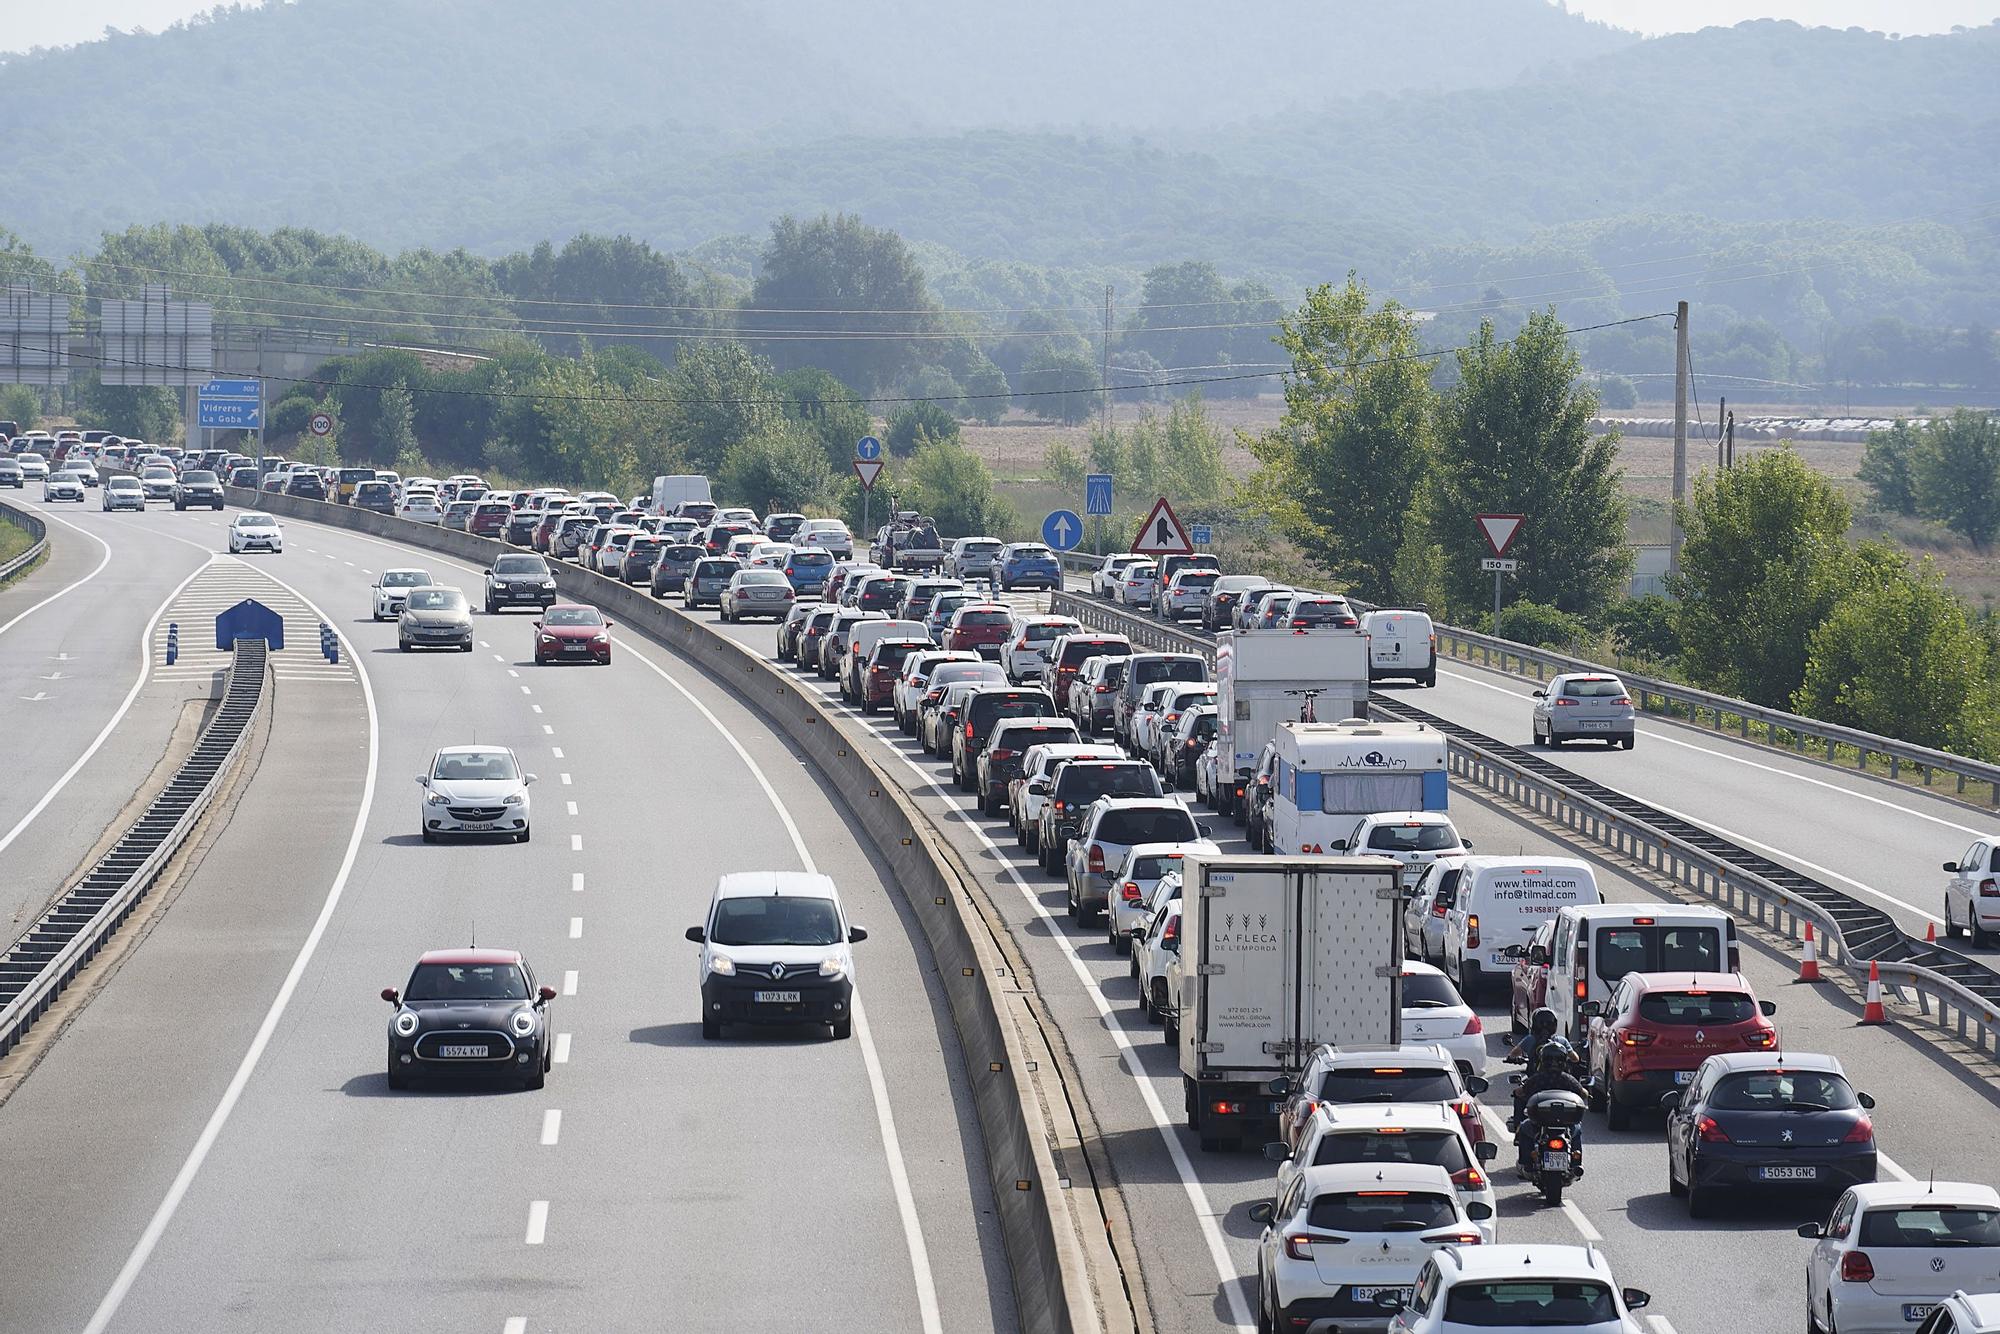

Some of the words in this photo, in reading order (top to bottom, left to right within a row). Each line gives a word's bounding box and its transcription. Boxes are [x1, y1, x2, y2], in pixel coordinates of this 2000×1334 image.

[203, 404, 242, 413] Vidreres
[202, 415, 214, 423] La
[314, 421, 328, 429] 100
[1486, 561, 1502, 569] 150
[1494, 878, 1577, 888] www.tilmad.com
[1494, 889, 1577, 900] info@tilmad.com
[1214, 933, 1230, 943] LA
[1236, 933, 1277, 943] FLECA
[762, 992, 781, 1001] 1073
[782, 992, 798, 1001] LRK
[446, 1046, 468, 1056] 5574
[470, 1046, 487, 1056] KYP
[1767, 1167, 1793, 1178] 5053
[1795, 1167, 1816, 1178] GNC
